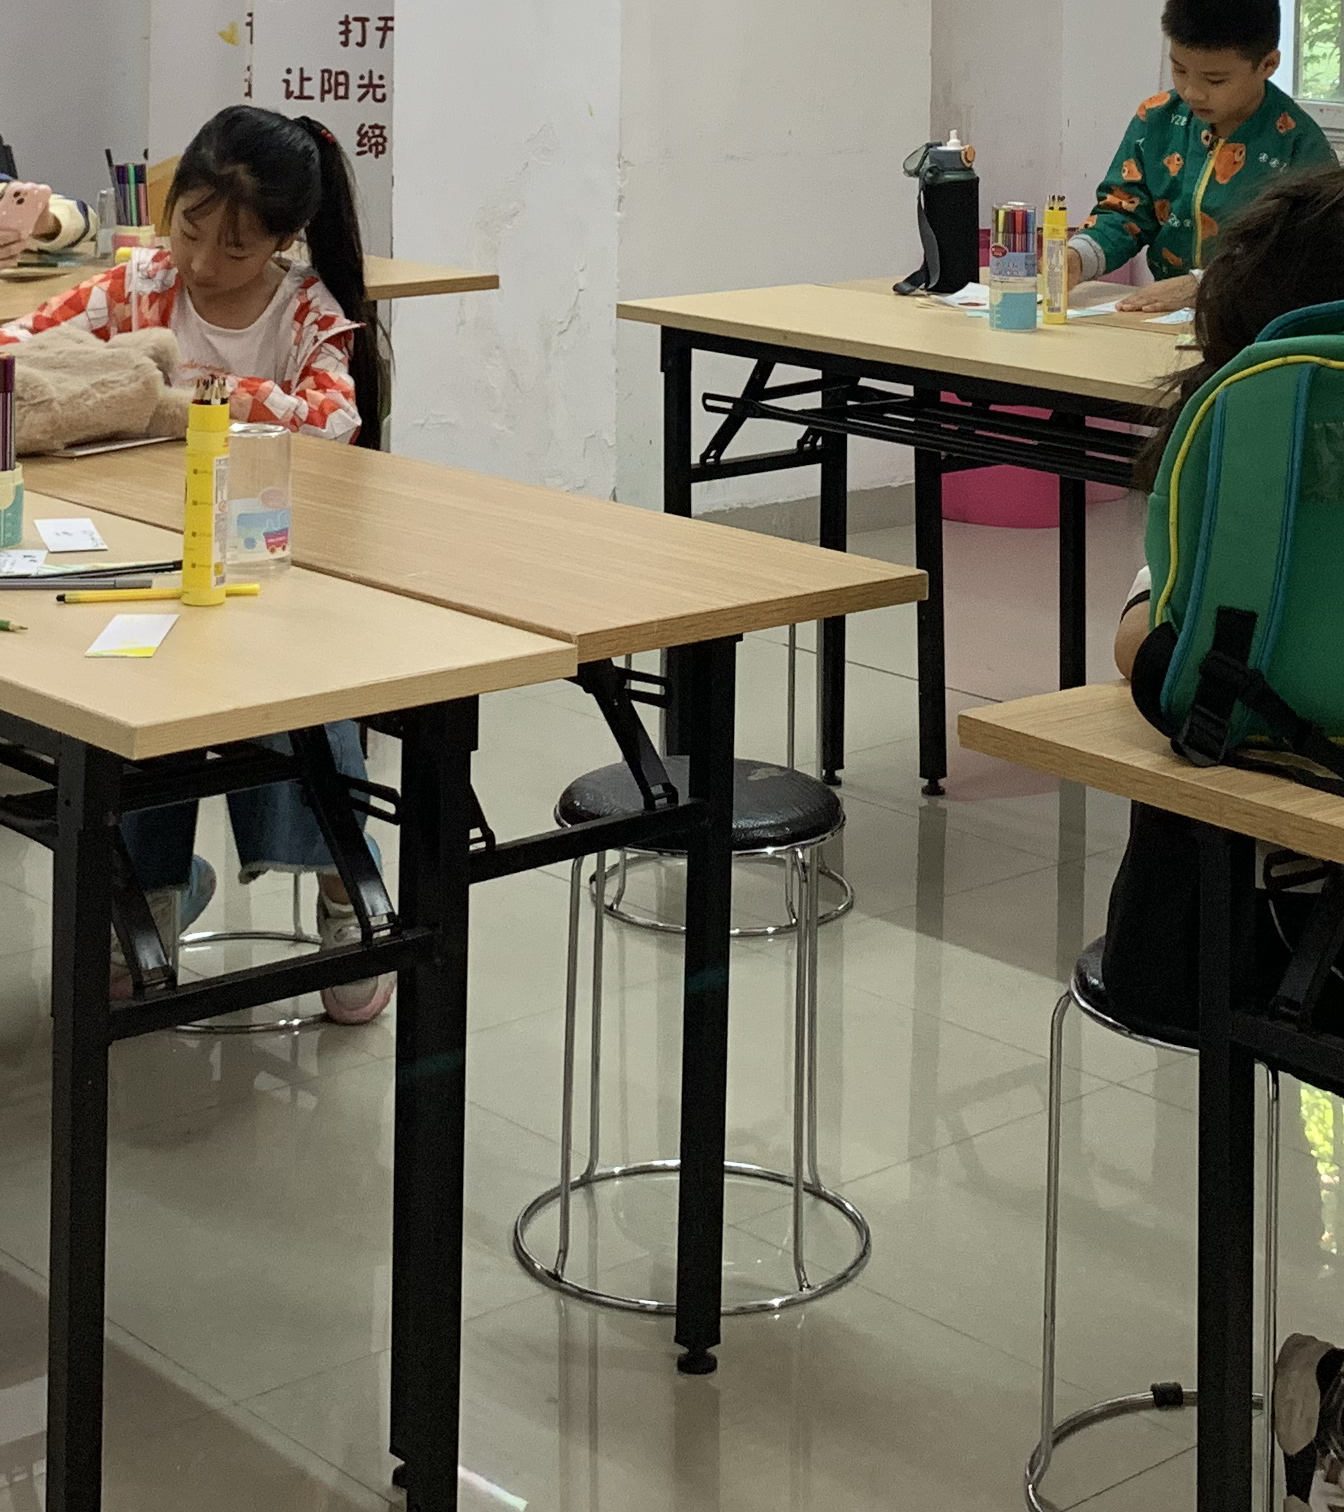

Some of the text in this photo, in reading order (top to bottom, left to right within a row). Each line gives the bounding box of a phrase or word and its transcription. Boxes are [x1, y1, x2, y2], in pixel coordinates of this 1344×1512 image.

[282, 66, 387, 104] 让阳光
[356, 122, 388, 159] 缔
